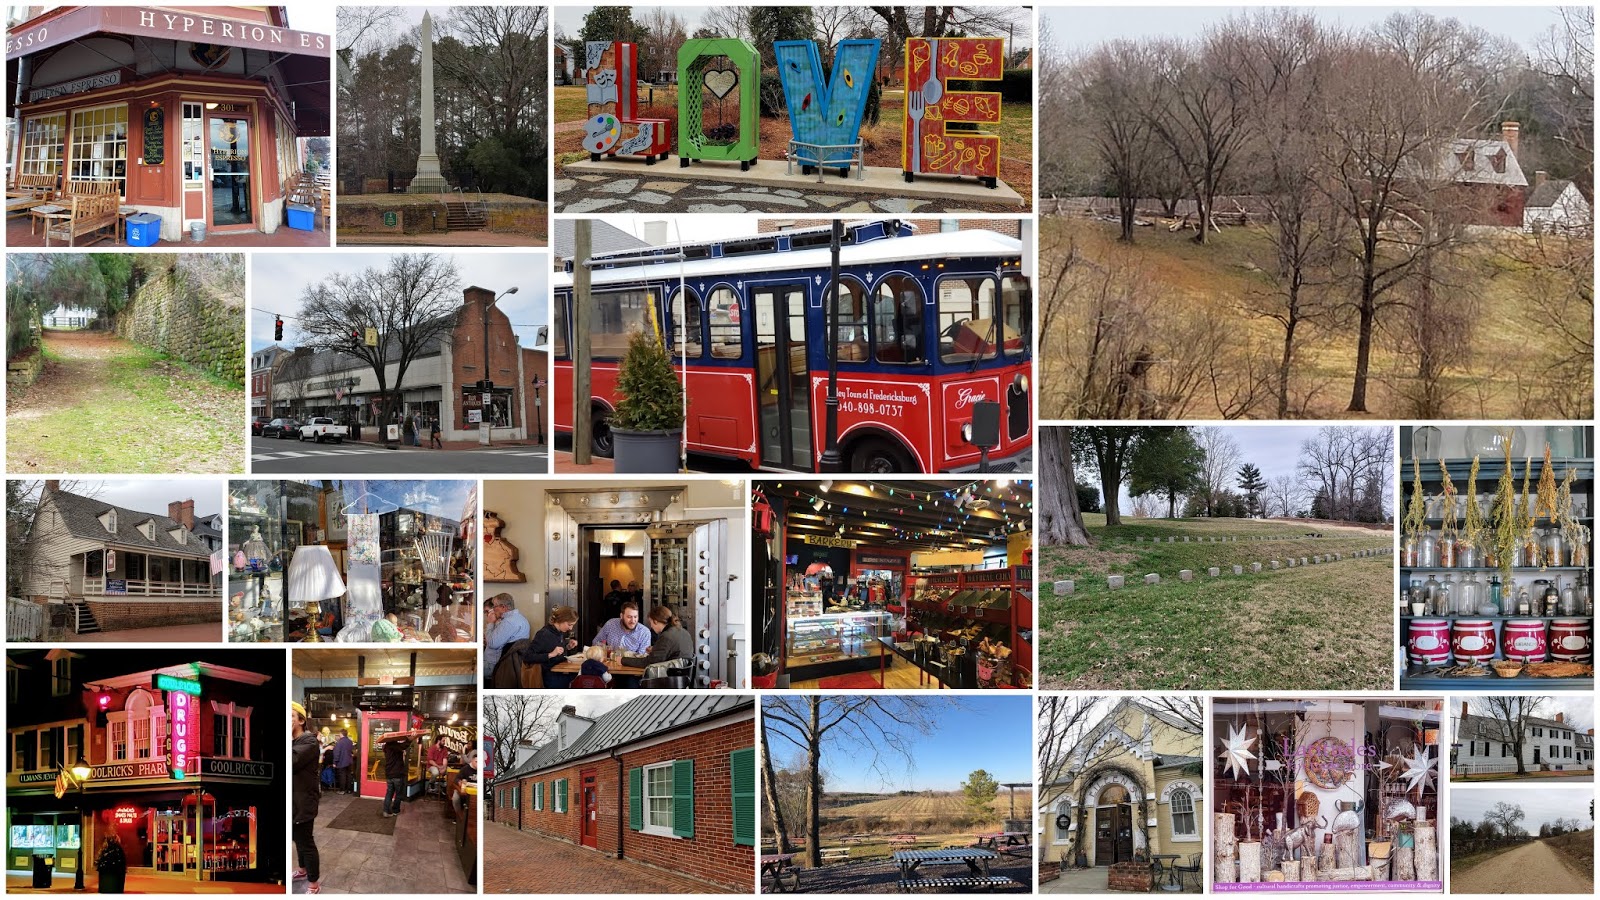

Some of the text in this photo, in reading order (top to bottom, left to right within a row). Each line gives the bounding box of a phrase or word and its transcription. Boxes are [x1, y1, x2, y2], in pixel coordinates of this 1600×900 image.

[139, 10, 283, 44] HYPERION
[71, 73, 118, 94] ESPRESSO
[220, 103, 235, 112] 301
[584, 37, 1004, 180] LOVE
[730, 309, 740, 318] STO
[846, 387, 863, 399] Tours
[863, 388, 869, 399] of
[869, 388, 918, 405] Fredericksburg
[175, 693, 187, 767] DRUGS
[1282, 736, 1377, 758] Latitudes
[91, 765, 134, 779] OOLRICK'S
[210, 760, 265, 776] GOOLRICK'S
